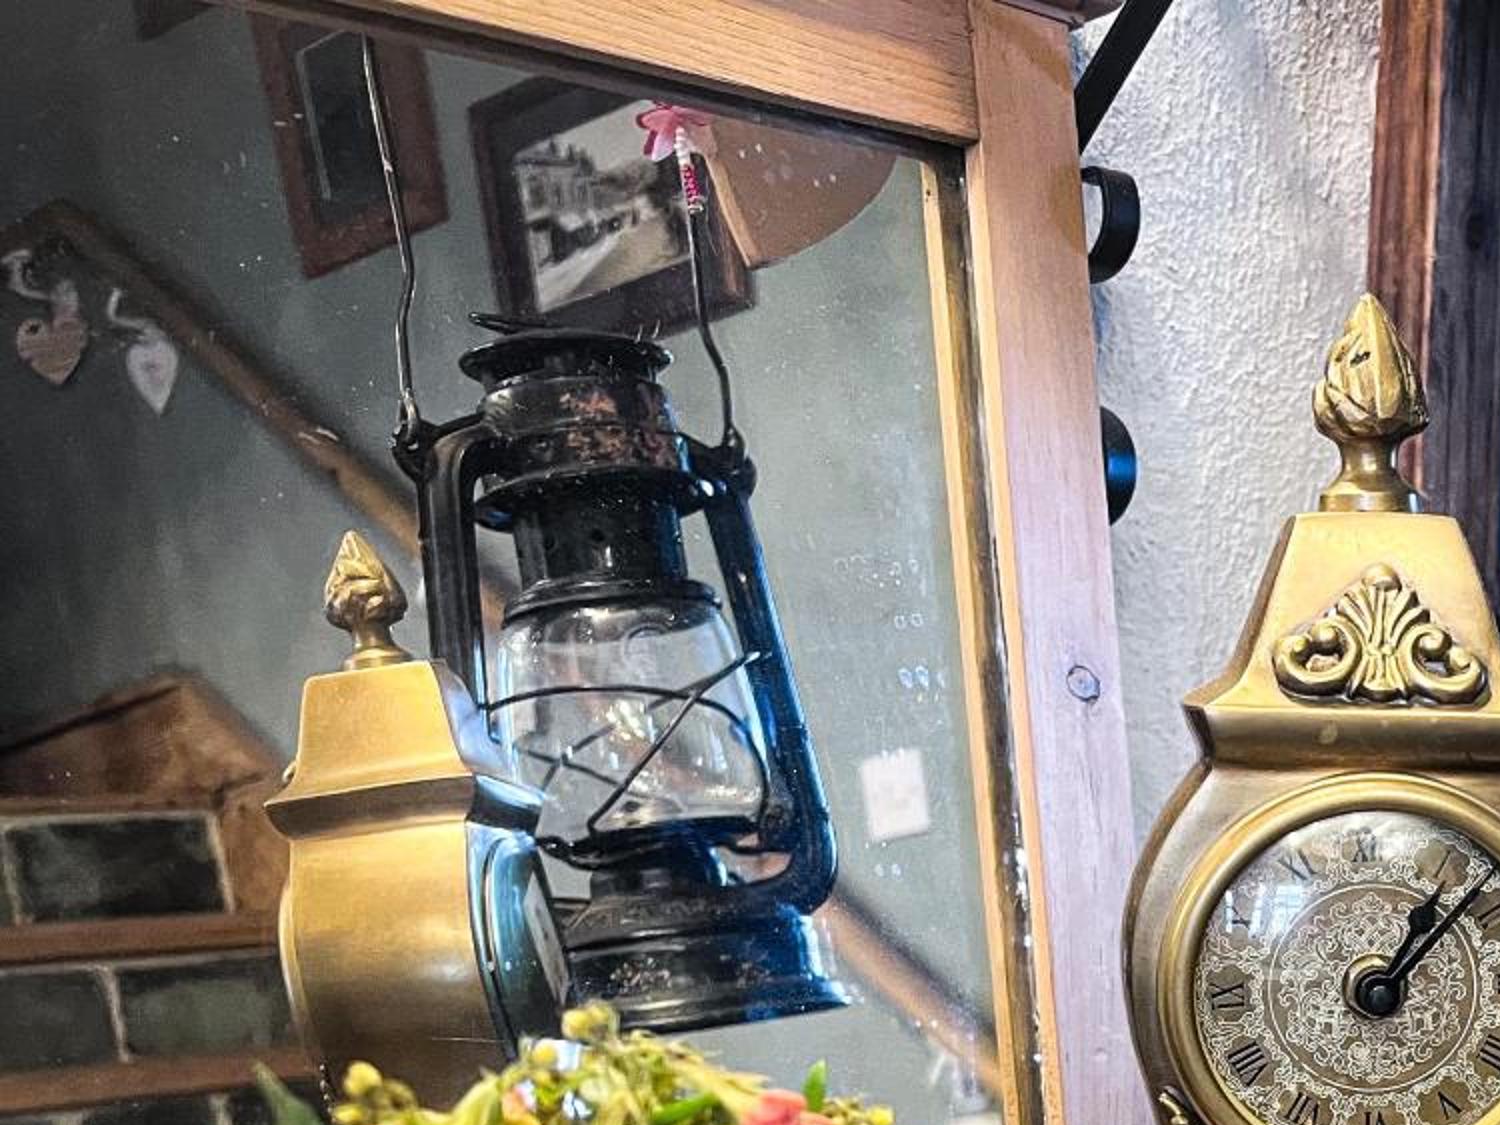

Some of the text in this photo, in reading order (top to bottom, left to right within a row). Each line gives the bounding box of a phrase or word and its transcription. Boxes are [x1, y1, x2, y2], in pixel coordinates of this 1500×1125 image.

[1277, 848, 1318, 882] XI
[1227, 1041, 1271, 1087] VIII
[1437, 1091, 1462, 1120] V
